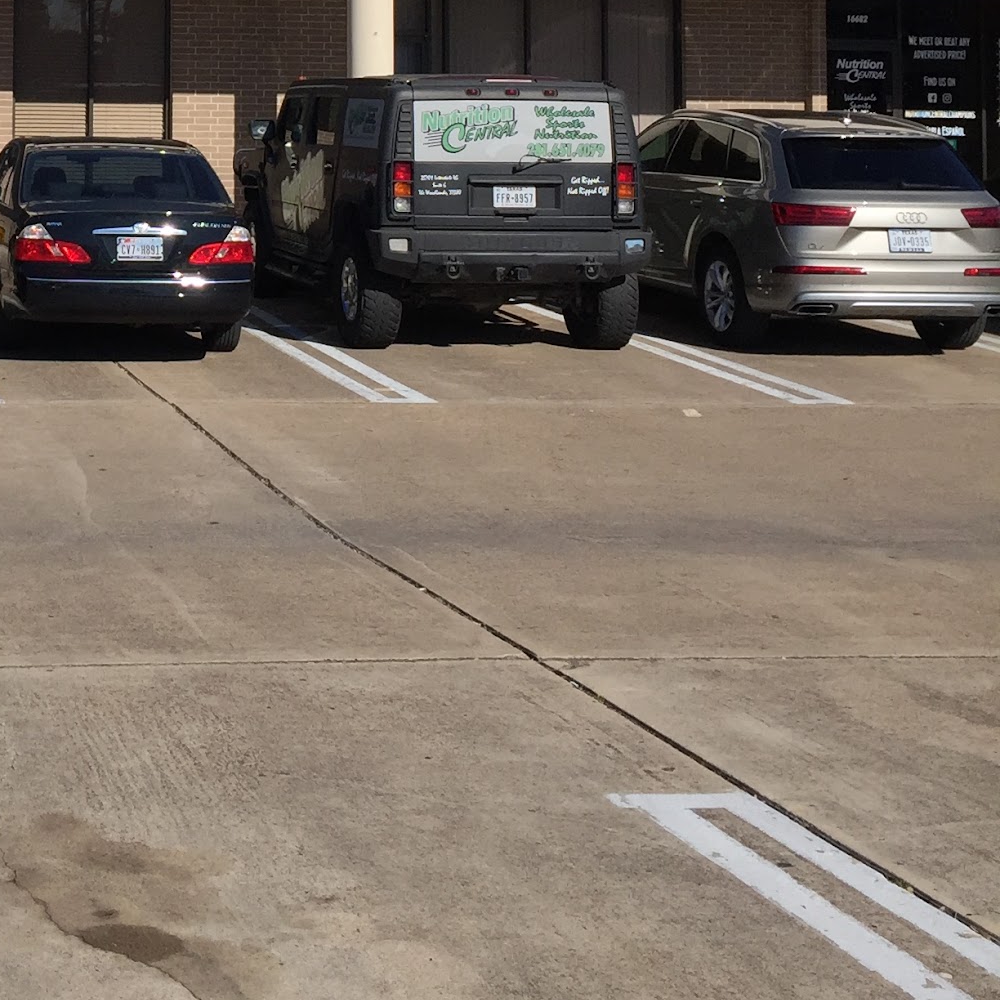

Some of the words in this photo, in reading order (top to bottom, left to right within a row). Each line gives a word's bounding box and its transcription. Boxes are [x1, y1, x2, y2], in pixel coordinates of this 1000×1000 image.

[836, 59, 884, 69] Nutrition
[534, 105, 595, 118] Wholesale
[421, 104, 515, 133] Nutrition
[545, 117, 585, 130] Sports
[441, 120, 518, 153] CENTRAL
[534, 128, 598, 140] Nutrition
